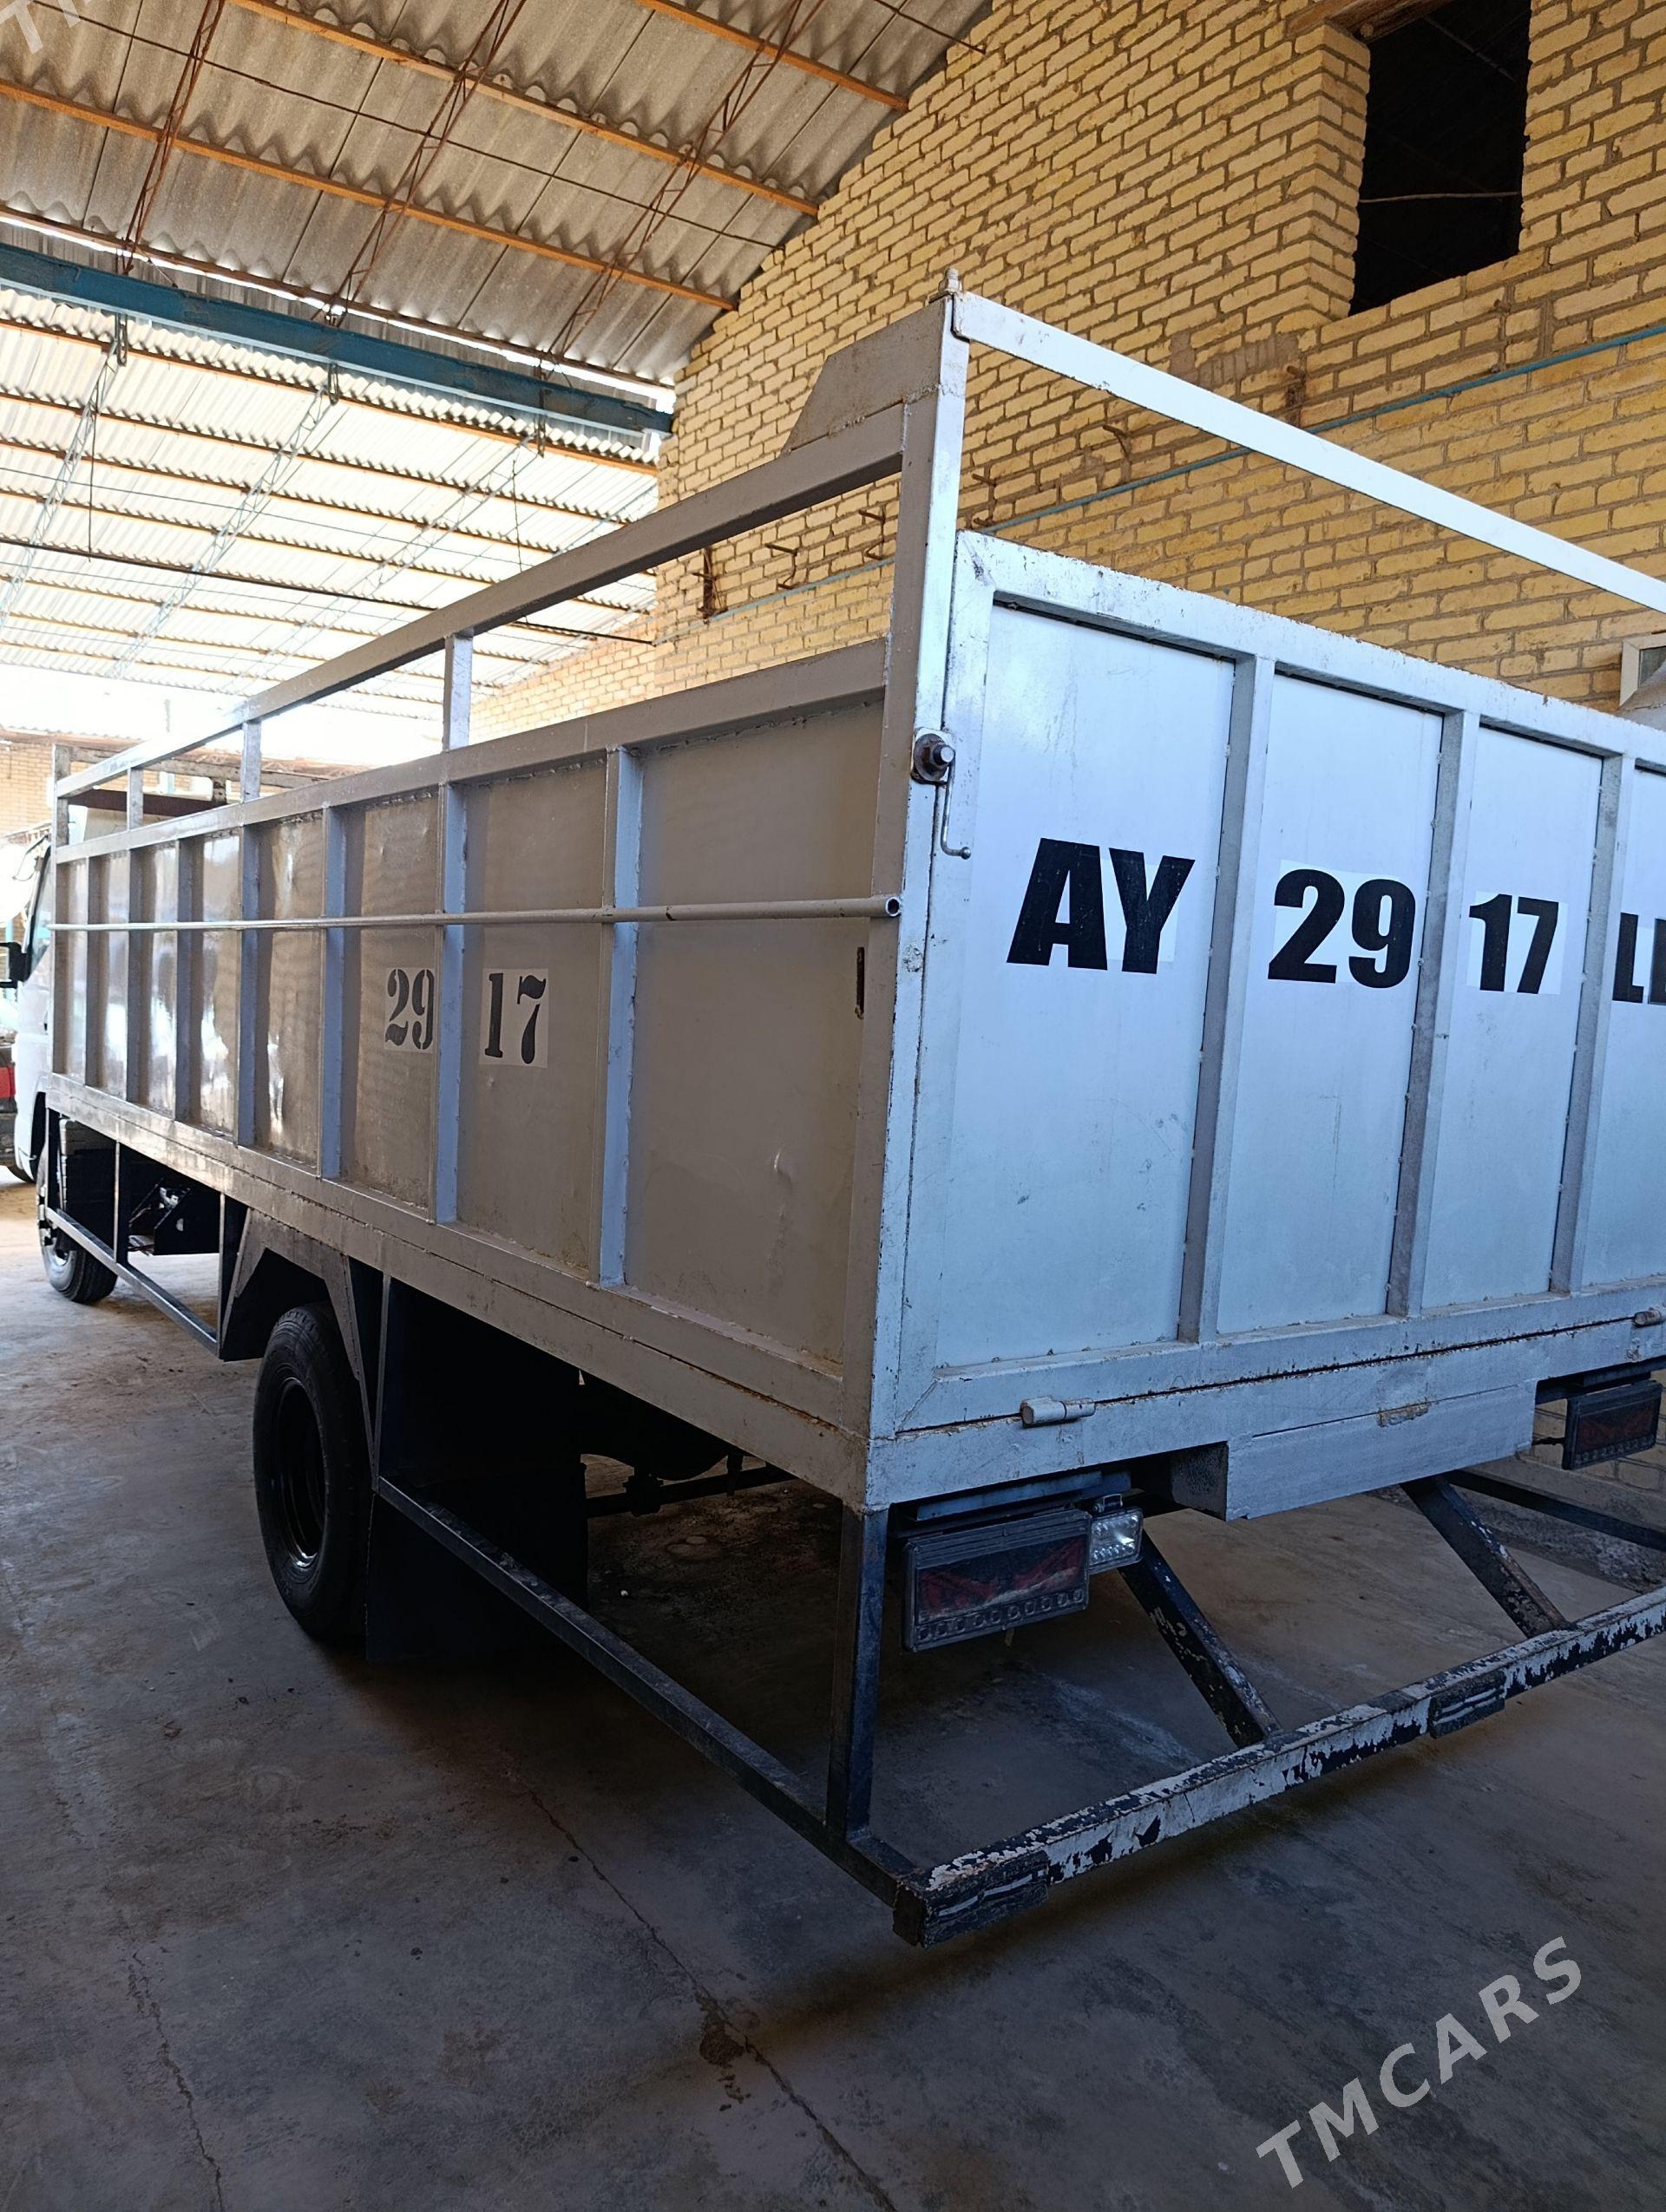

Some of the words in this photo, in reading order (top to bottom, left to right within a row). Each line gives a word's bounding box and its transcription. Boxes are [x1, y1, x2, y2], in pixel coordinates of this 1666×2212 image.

[1007, 837, 1196, 974] AY
[1268, 868, 1417, 988] 29
[1468, 893, 1560, 994] 17
[385, 968, 434, 1050] 29
[484, 972, 547, 1064] 17
